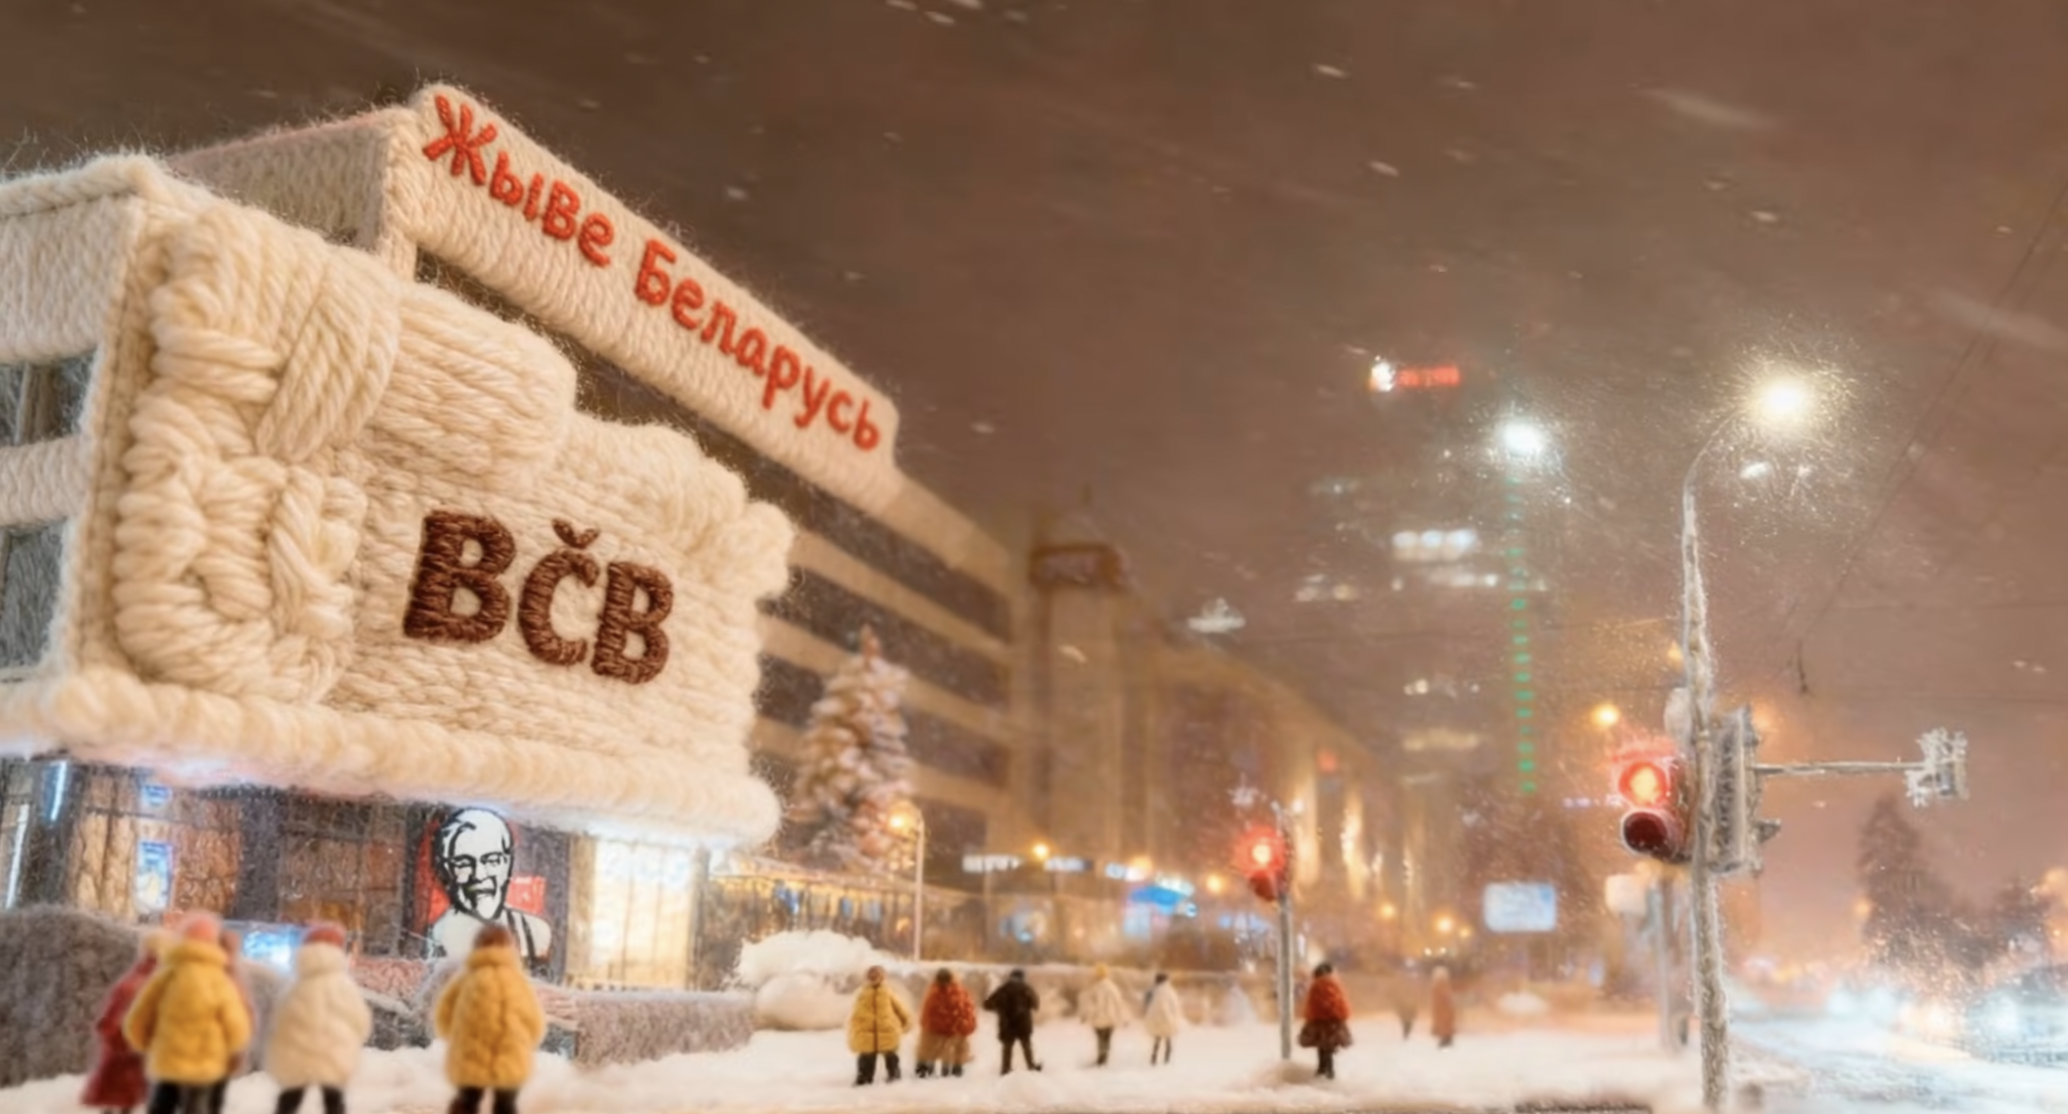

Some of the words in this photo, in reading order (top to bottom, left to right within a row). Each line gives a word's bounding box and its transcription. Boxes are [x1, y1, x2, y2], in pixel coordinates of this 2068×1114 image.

[422, 93, 616, 269] Жыве
[634, 237, 882, 453] Беларусь
[402, 510, 675, 685] BČB
